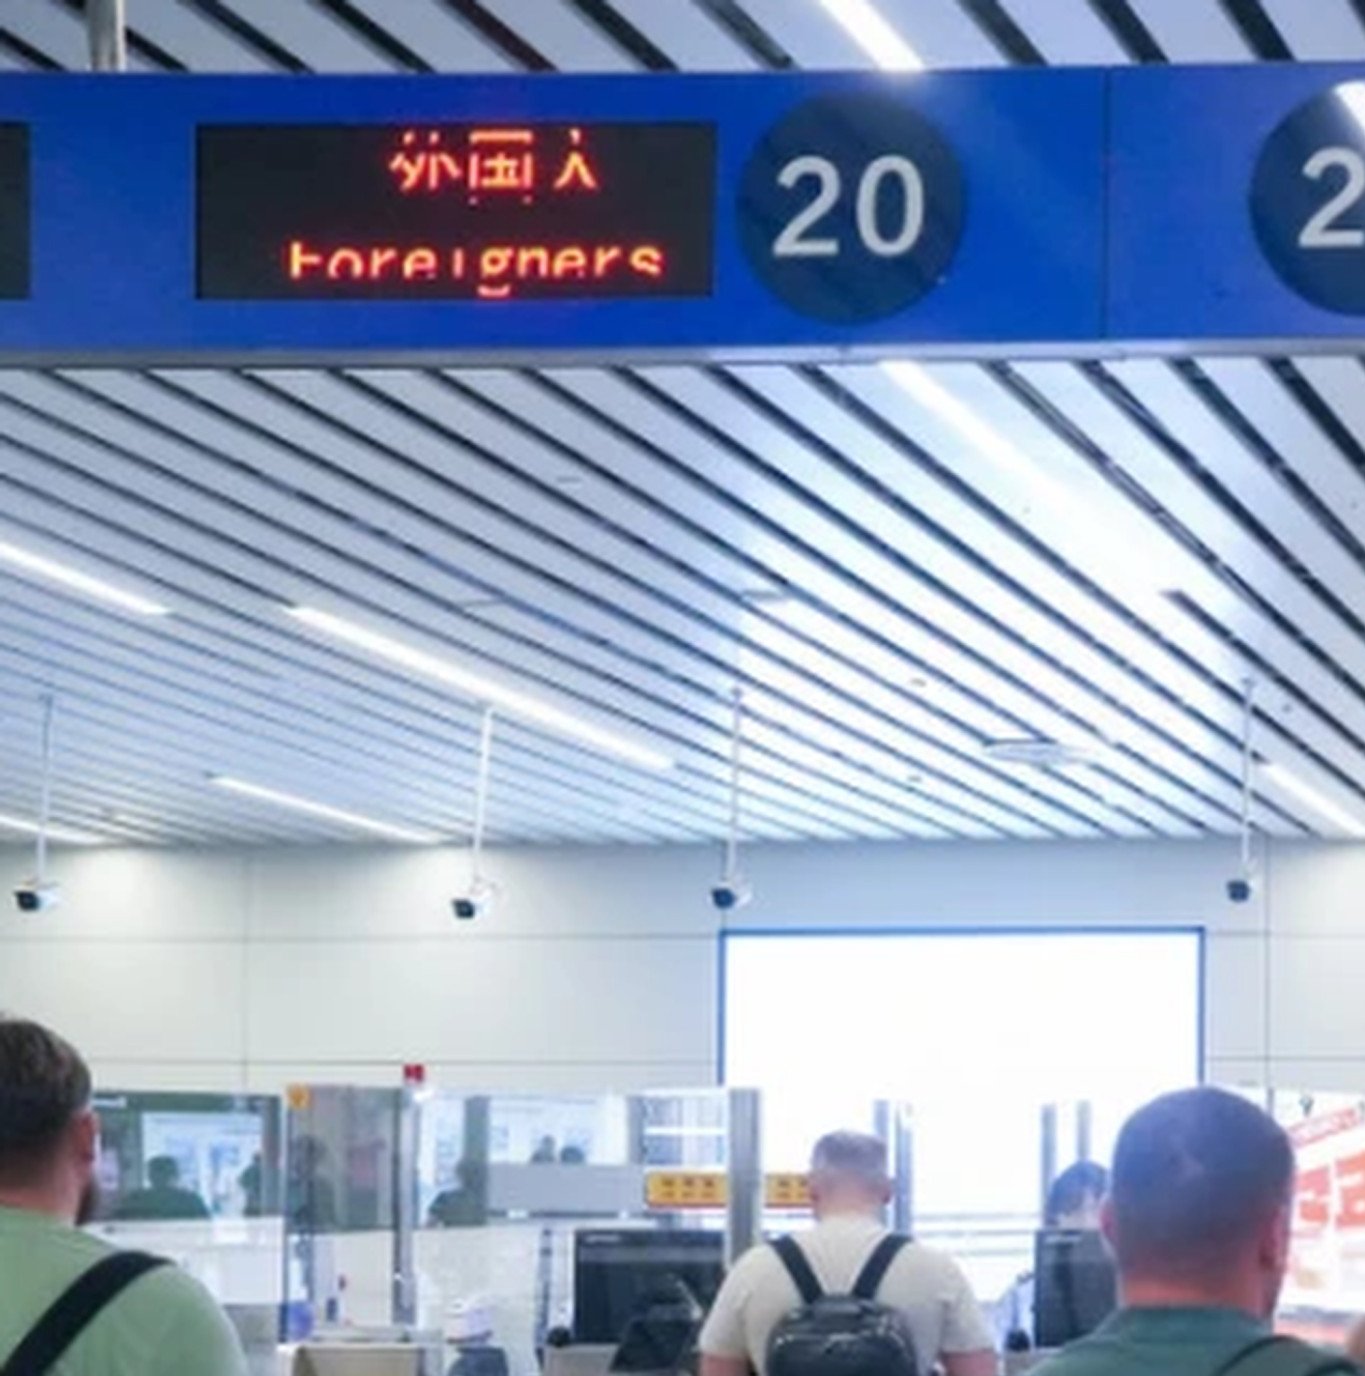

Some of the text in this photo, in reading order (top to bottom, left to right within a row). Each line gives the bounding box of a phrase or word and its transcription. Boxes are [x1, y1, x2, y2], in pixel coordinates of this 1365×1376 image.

[388, 129, 598, 202] 外国人
[772, 155, 925, 256] 20
